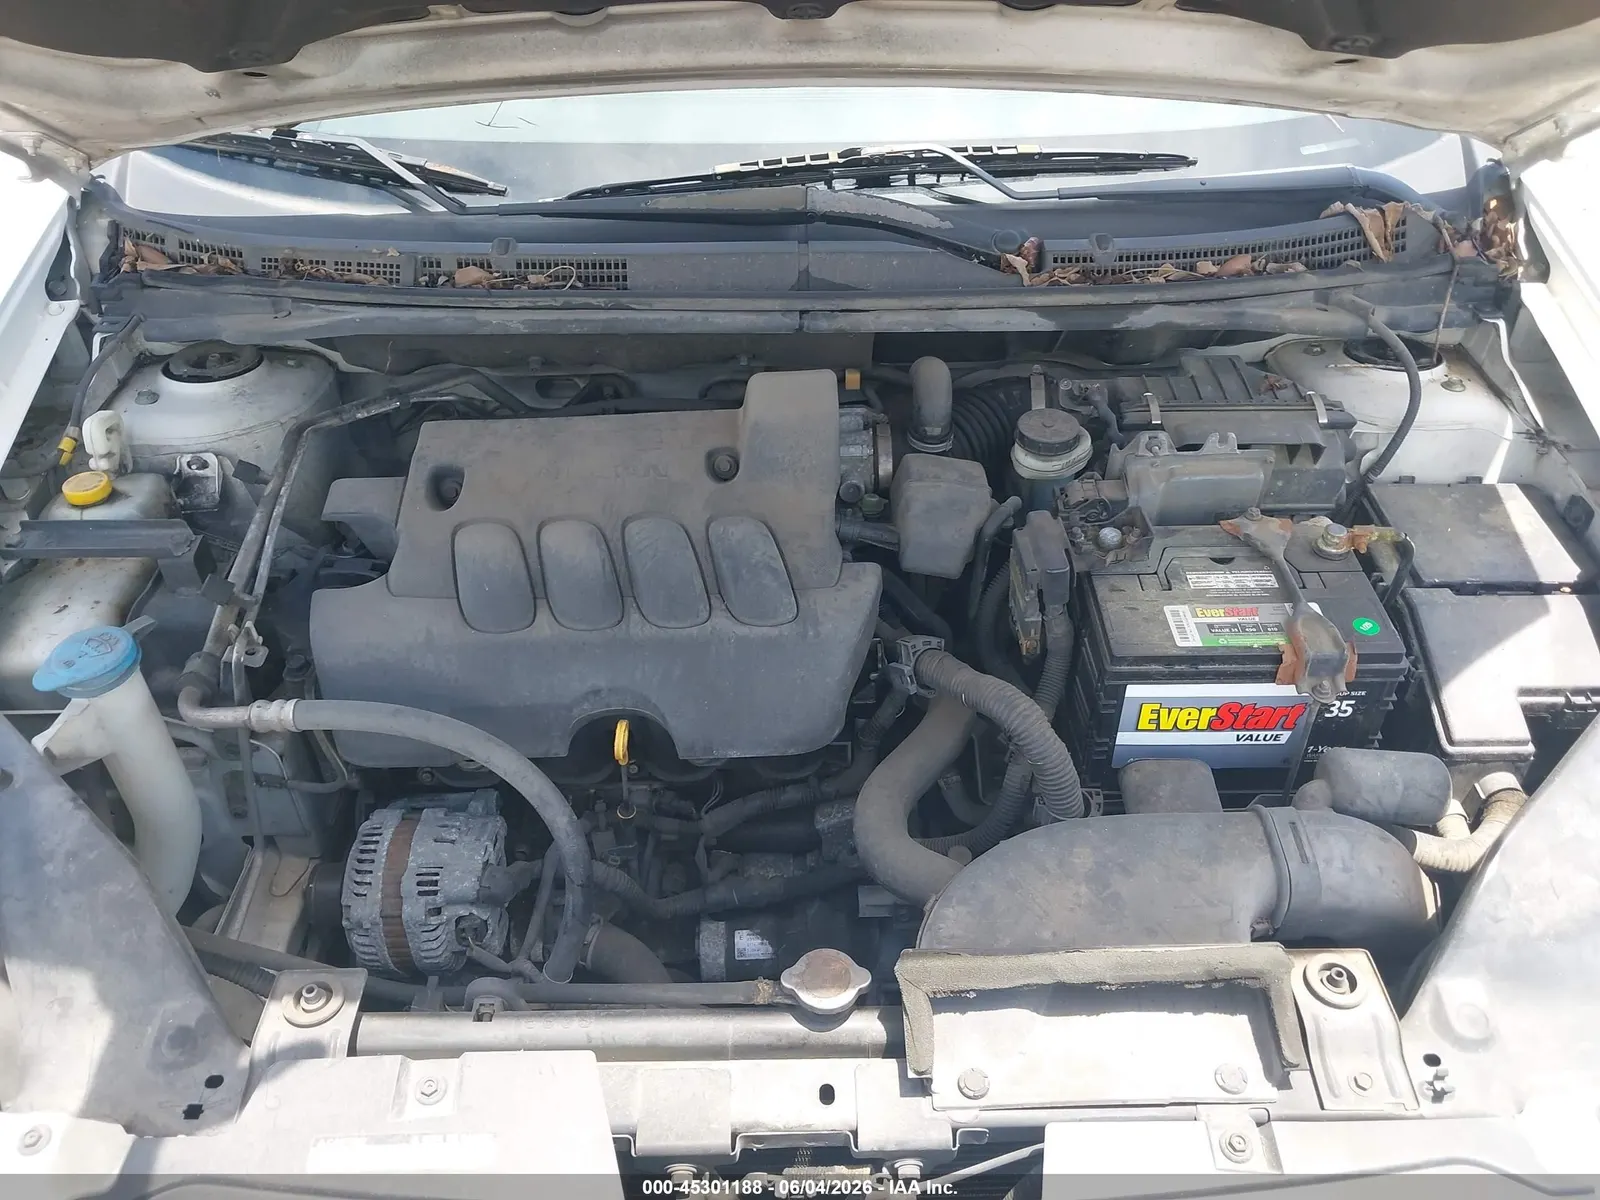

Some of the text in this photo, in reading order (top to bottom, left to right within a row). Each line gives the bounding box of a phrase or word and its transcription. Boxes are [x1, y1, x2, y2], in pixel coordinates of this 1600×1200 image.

[1195, 606, 1259, 618] EverStart
[1324, 700, 1356, 718] 35
[1136, 701, 1307, 733] EverStart
[1235, 733, 1284, 743] VALUE
